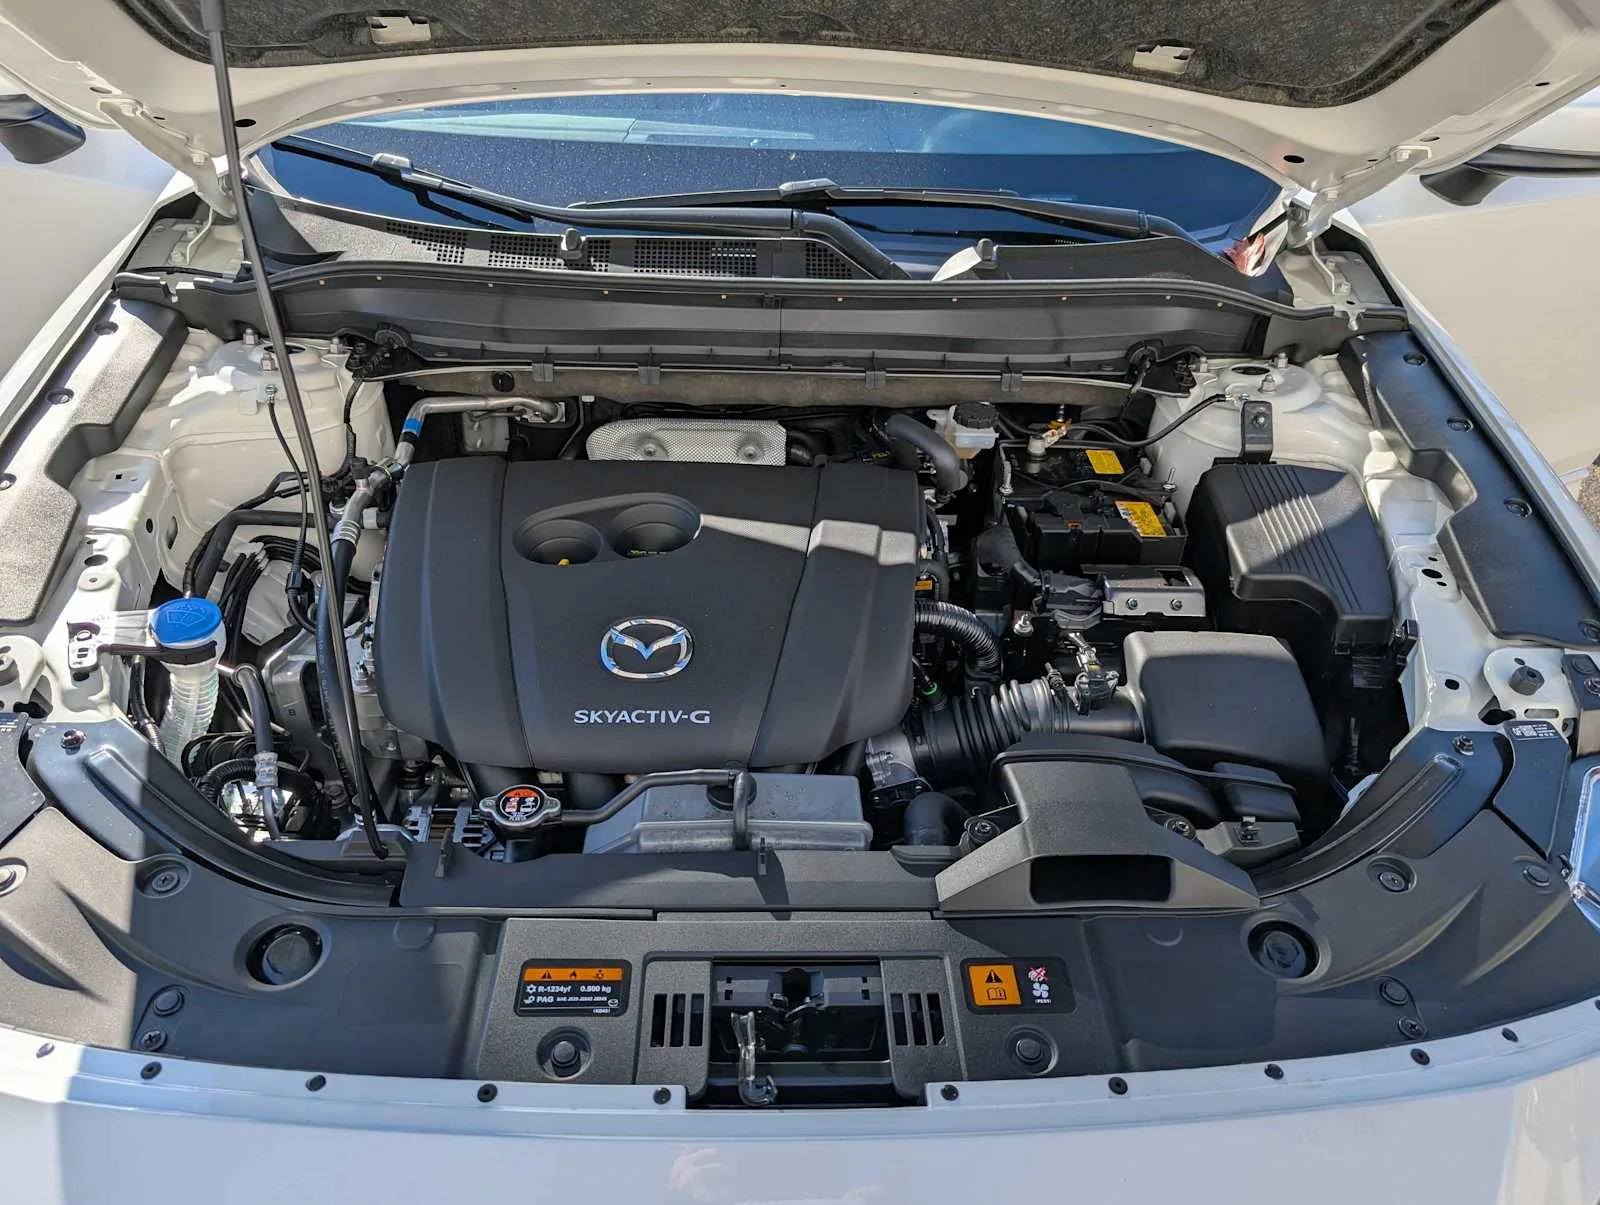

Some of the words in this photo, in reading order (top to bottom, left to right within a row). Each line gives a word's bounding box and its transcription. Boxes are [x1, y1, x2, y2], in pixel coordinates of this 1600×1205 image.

[573, 709, 711, 724] SKYACTIV-G
[538, 985, 571, 993] R-1234yf
[580, 985, 600, 993] 0.500
[602, 985, 611, 993] kg
[536, 995, 554, 1003] PAG
